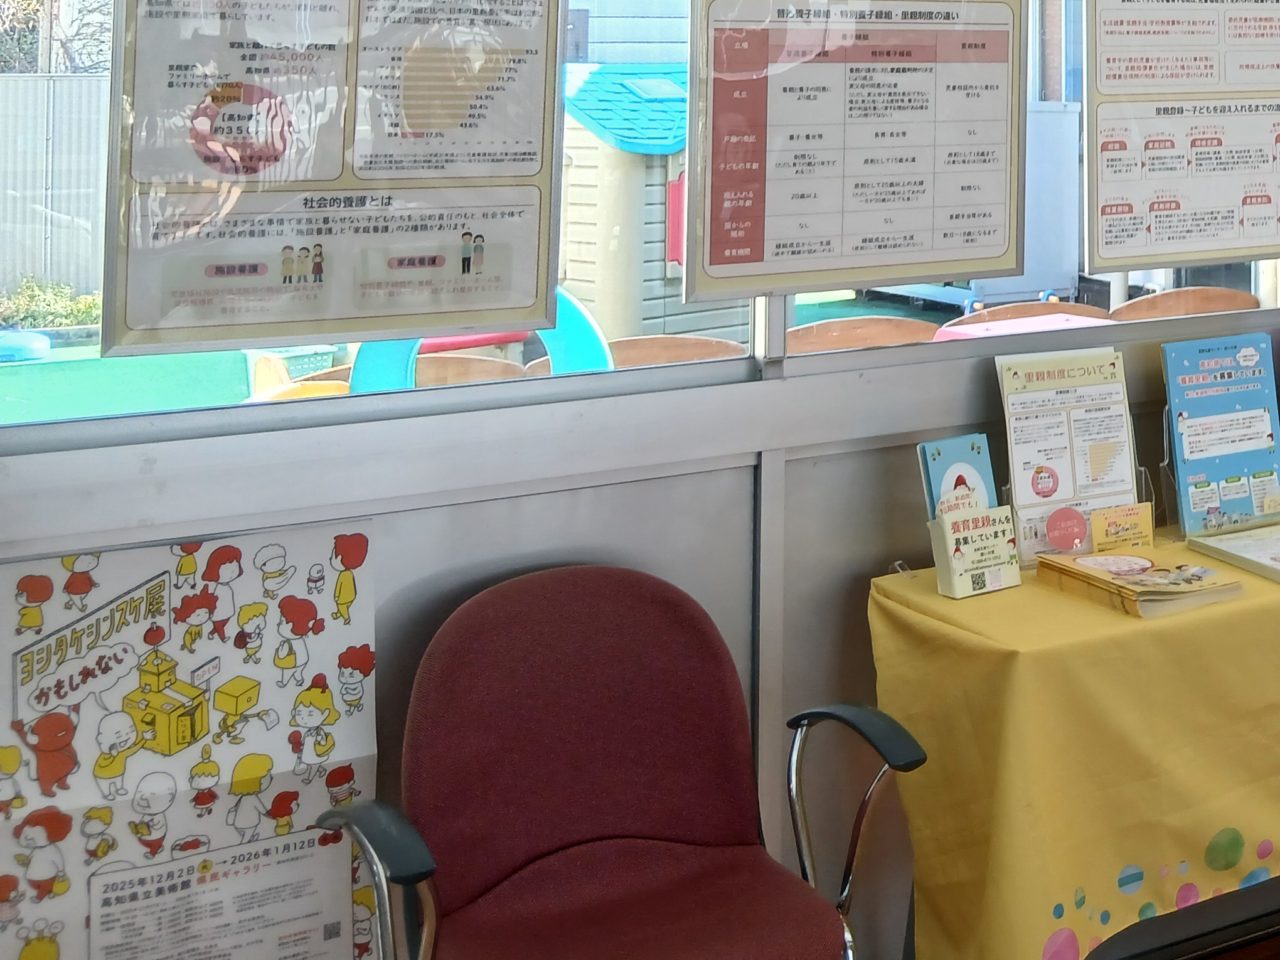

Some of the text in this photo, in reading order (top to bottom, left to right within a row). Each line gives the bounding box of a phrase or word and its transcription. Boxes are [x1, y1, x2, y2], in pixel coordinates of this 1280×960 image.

[719, 162, 759, 170] 子どもの年齢
[302, 195, 393, 209] 社会的養護とは
[214, 256, 437, 276] 施設養護 家庭養護
[1024, 365, 1105, 384] 里親制度について
[951, 514, 1011, 535] 養育里親さんを
[20, 578, 167, 688] ヨシタケシンスケ展
[34, 646, 129, 707] かもしれない
[102, 866, 195, 894] 2025年12月2日
[230, 838, 316, 865] 2026年1月12日
[100, 878, 192, 908] 高知県立美術館
